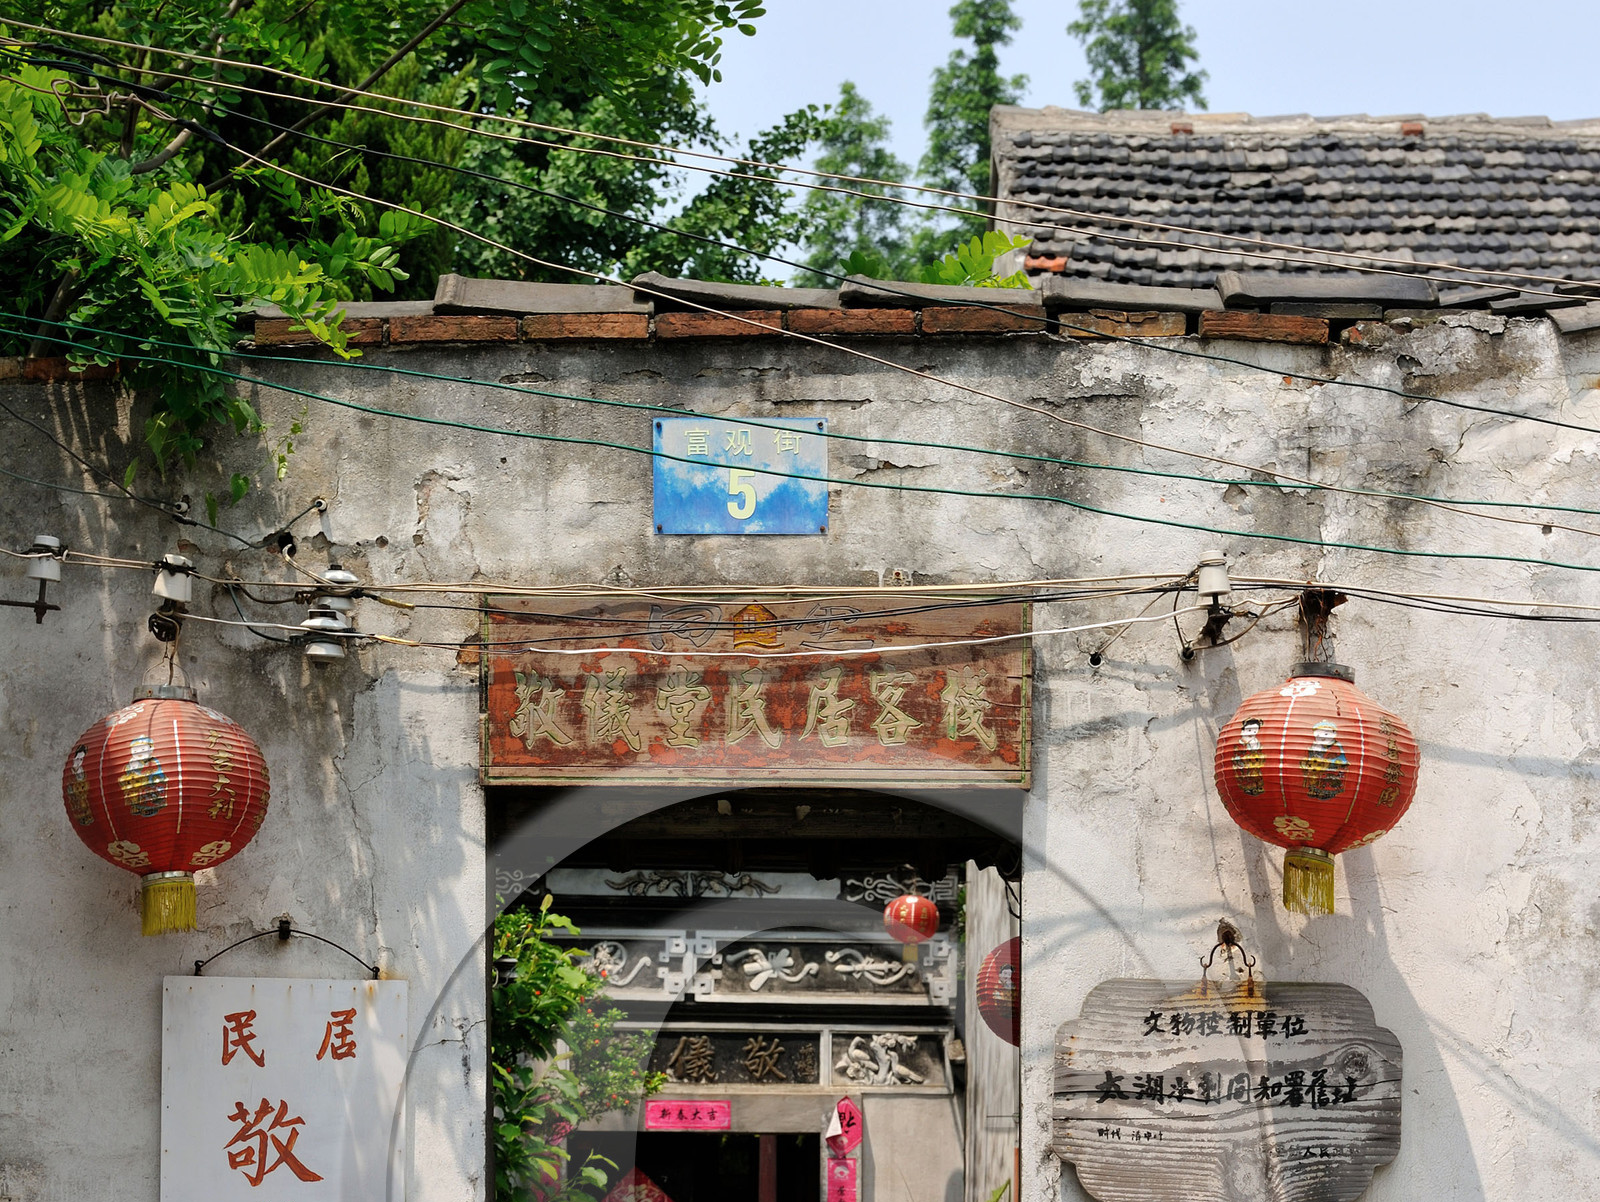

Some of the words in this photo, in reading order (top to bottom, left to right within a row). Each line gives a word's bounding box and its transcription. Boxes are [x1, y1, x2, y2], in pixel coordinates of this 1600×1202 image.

[684, 428, 803, 456] 富观街
[727, 468, 758, 520] 5
